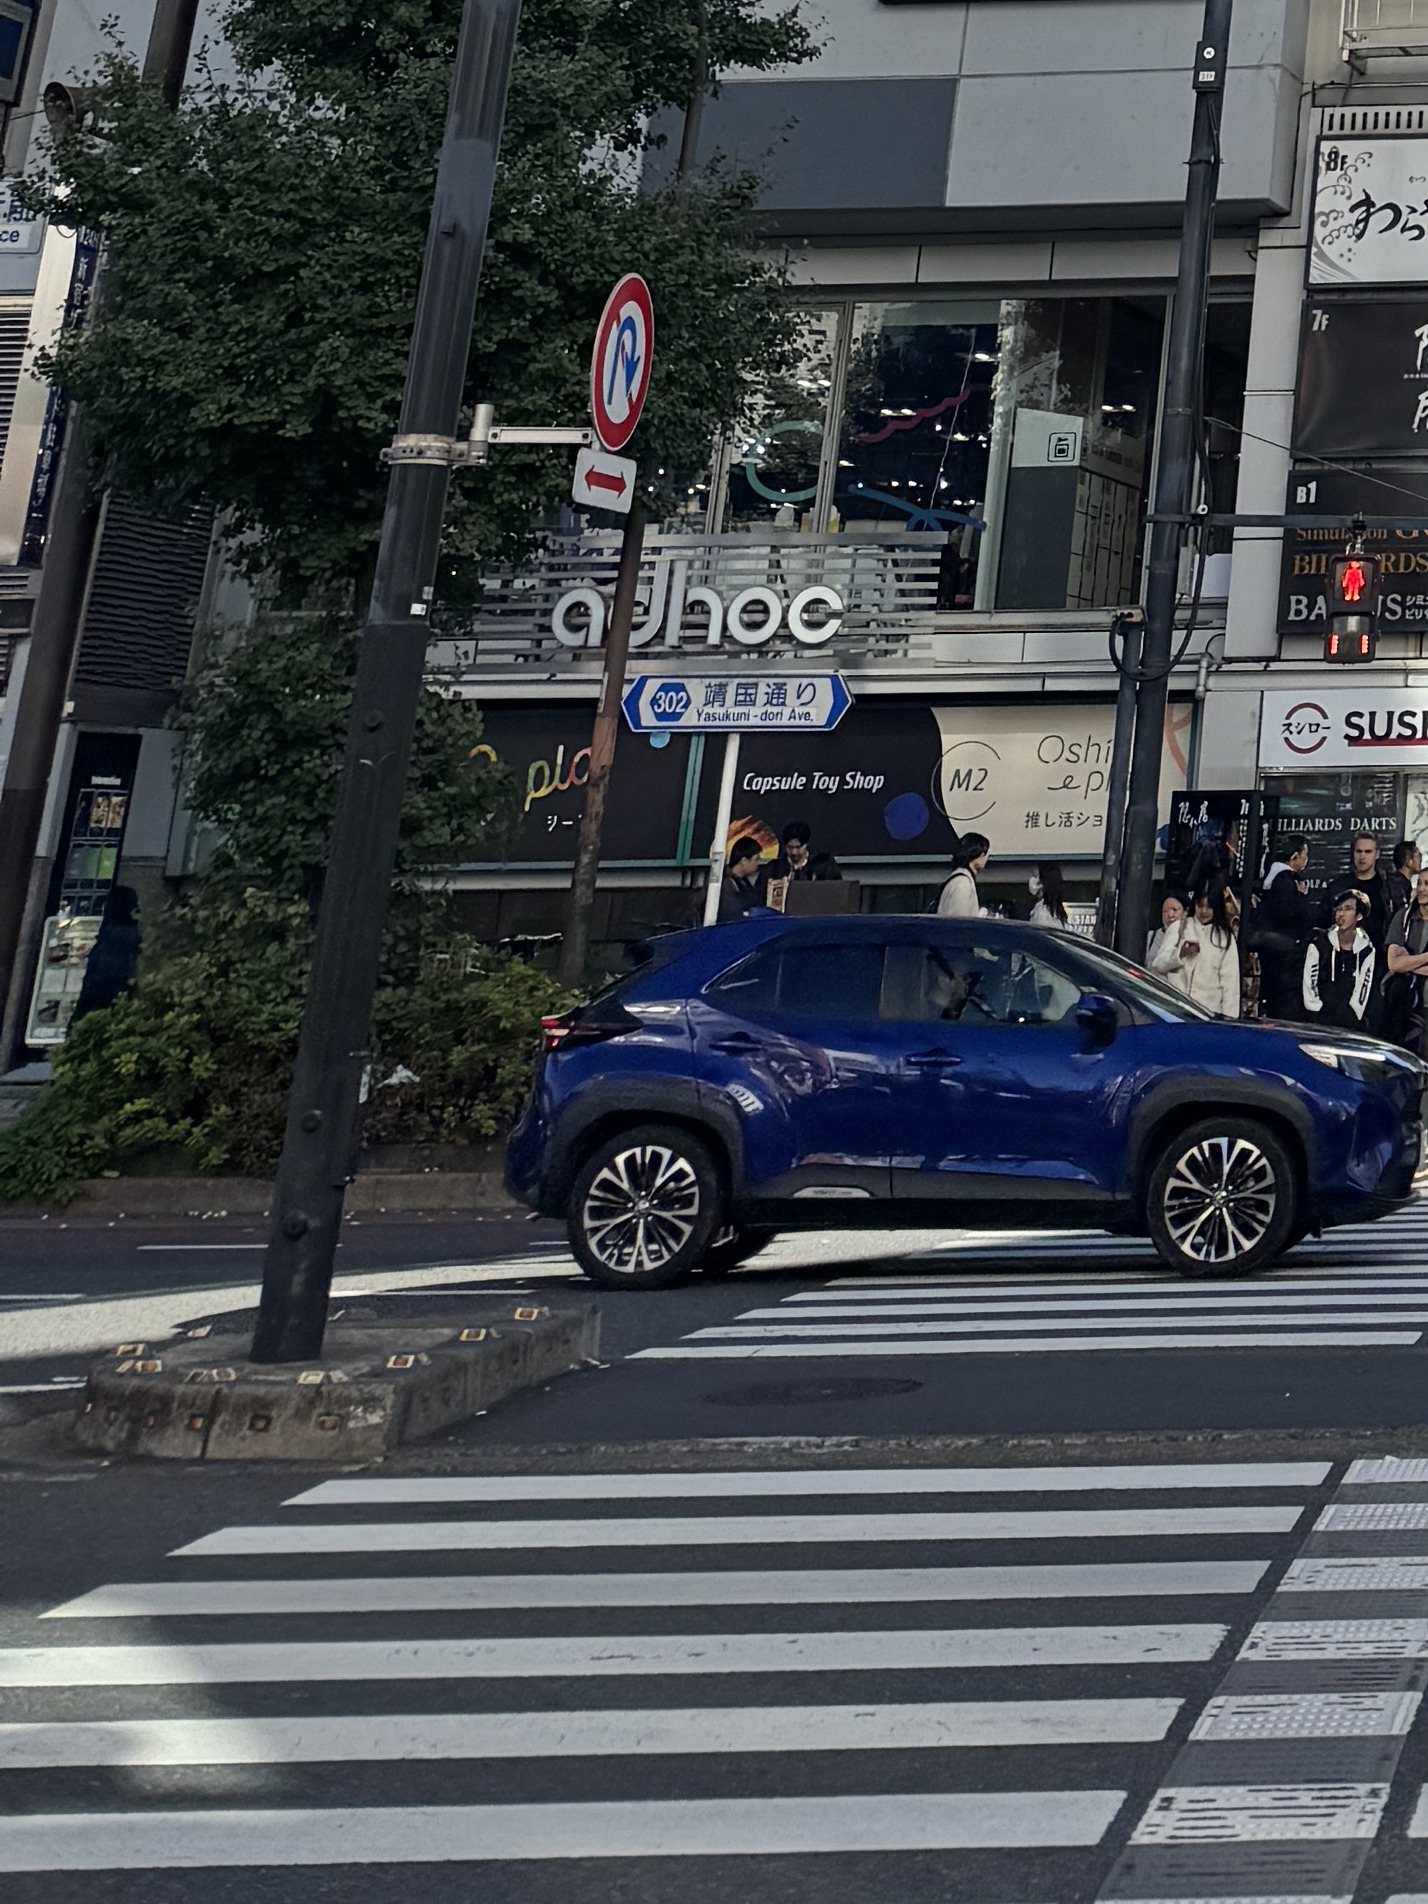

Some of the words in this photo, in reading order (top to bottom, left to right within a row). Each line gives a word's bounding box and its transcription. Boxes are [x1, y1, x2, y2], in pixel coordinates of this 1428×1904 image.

[1326, 150, 1348, 171] 8F
[1312, 310, 1330, 331] 7F
[1296, 481, 1317, 504] B1
[654, 692, 687, 713] 302
[703, 682, 816, 708] 靖国通り
[1280, 718, 1331, 736] スシロー
[1037, 734, 1114, 764] Oshi
[743, 772, 806, 794] Capsule
[812, 772, 840, 794] Toy
[844, 771, 884, 793] Shop
[949, 767, 989, 792] M2
[1278, 817, 1343, 831] ILLIARDS
[1350, 817, 1397, 831] DARTS
